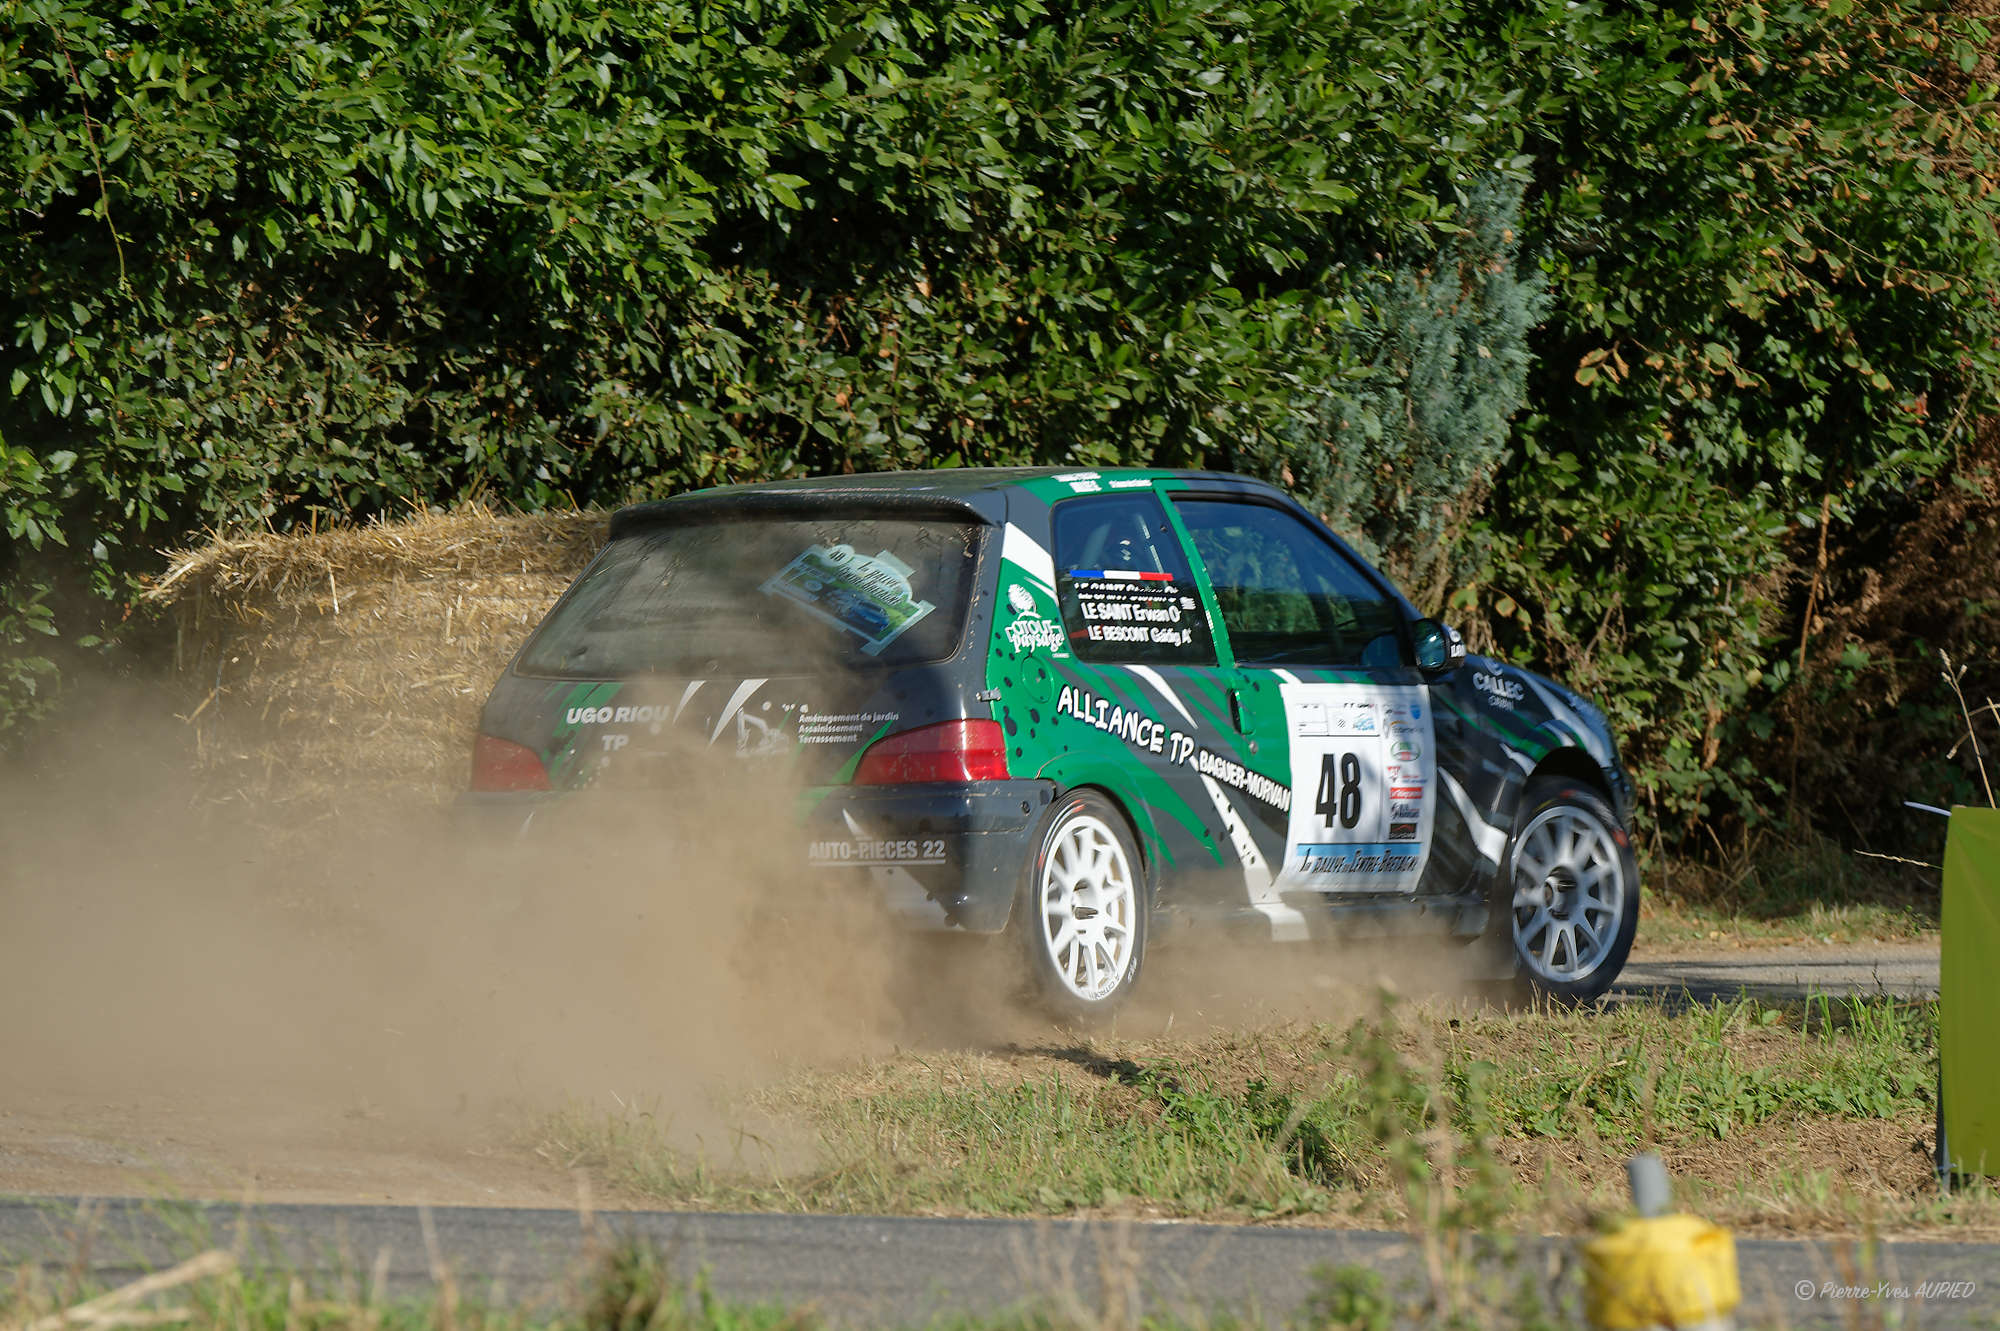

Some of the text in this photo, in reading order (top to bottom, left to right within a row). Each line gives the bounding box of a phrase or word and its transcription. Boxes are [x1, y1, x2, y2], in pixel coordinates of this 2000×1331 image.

[1097, 602, 1133, 621] SAINT
[1088, 625, 1104, 641] LE
[566, 705, 670, 724] UGO RIOU
[1056, 685, 1195, 766] ALLIANCE TP
[601, 734, 630, 752] TP
[1314, 752, 1362, 829] 48
[808, 840, 946, 860] AUTO-PIECES 22
